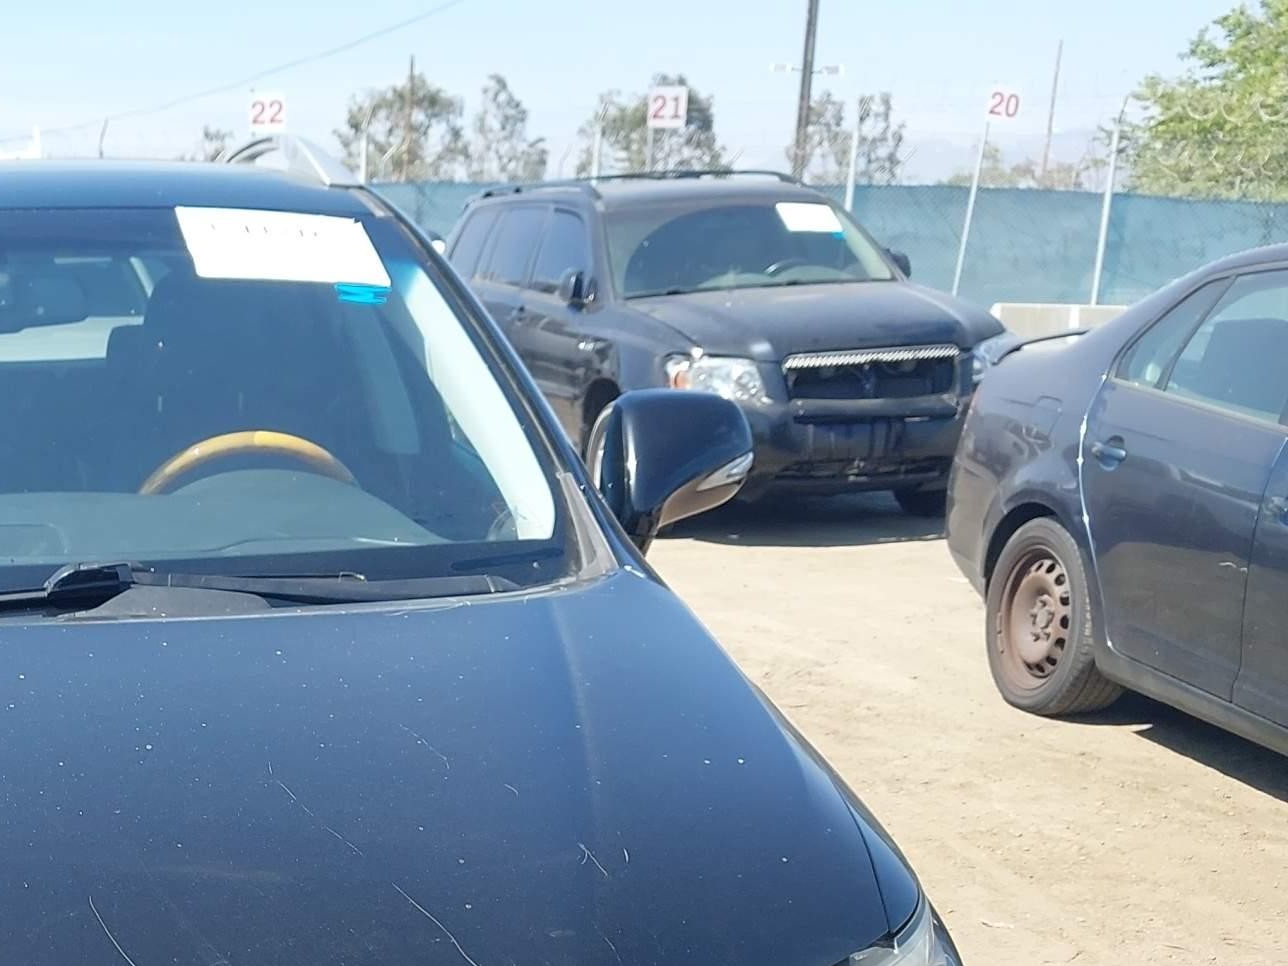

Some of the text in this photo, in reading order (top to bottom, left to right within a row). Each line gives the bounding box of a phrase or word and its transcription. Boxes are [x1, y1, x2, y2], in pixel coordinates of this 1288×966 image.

[251, 99, 283, 125] 22
[652, 94, 681, 120] 21
[988, 91, 1020, 118] 20
